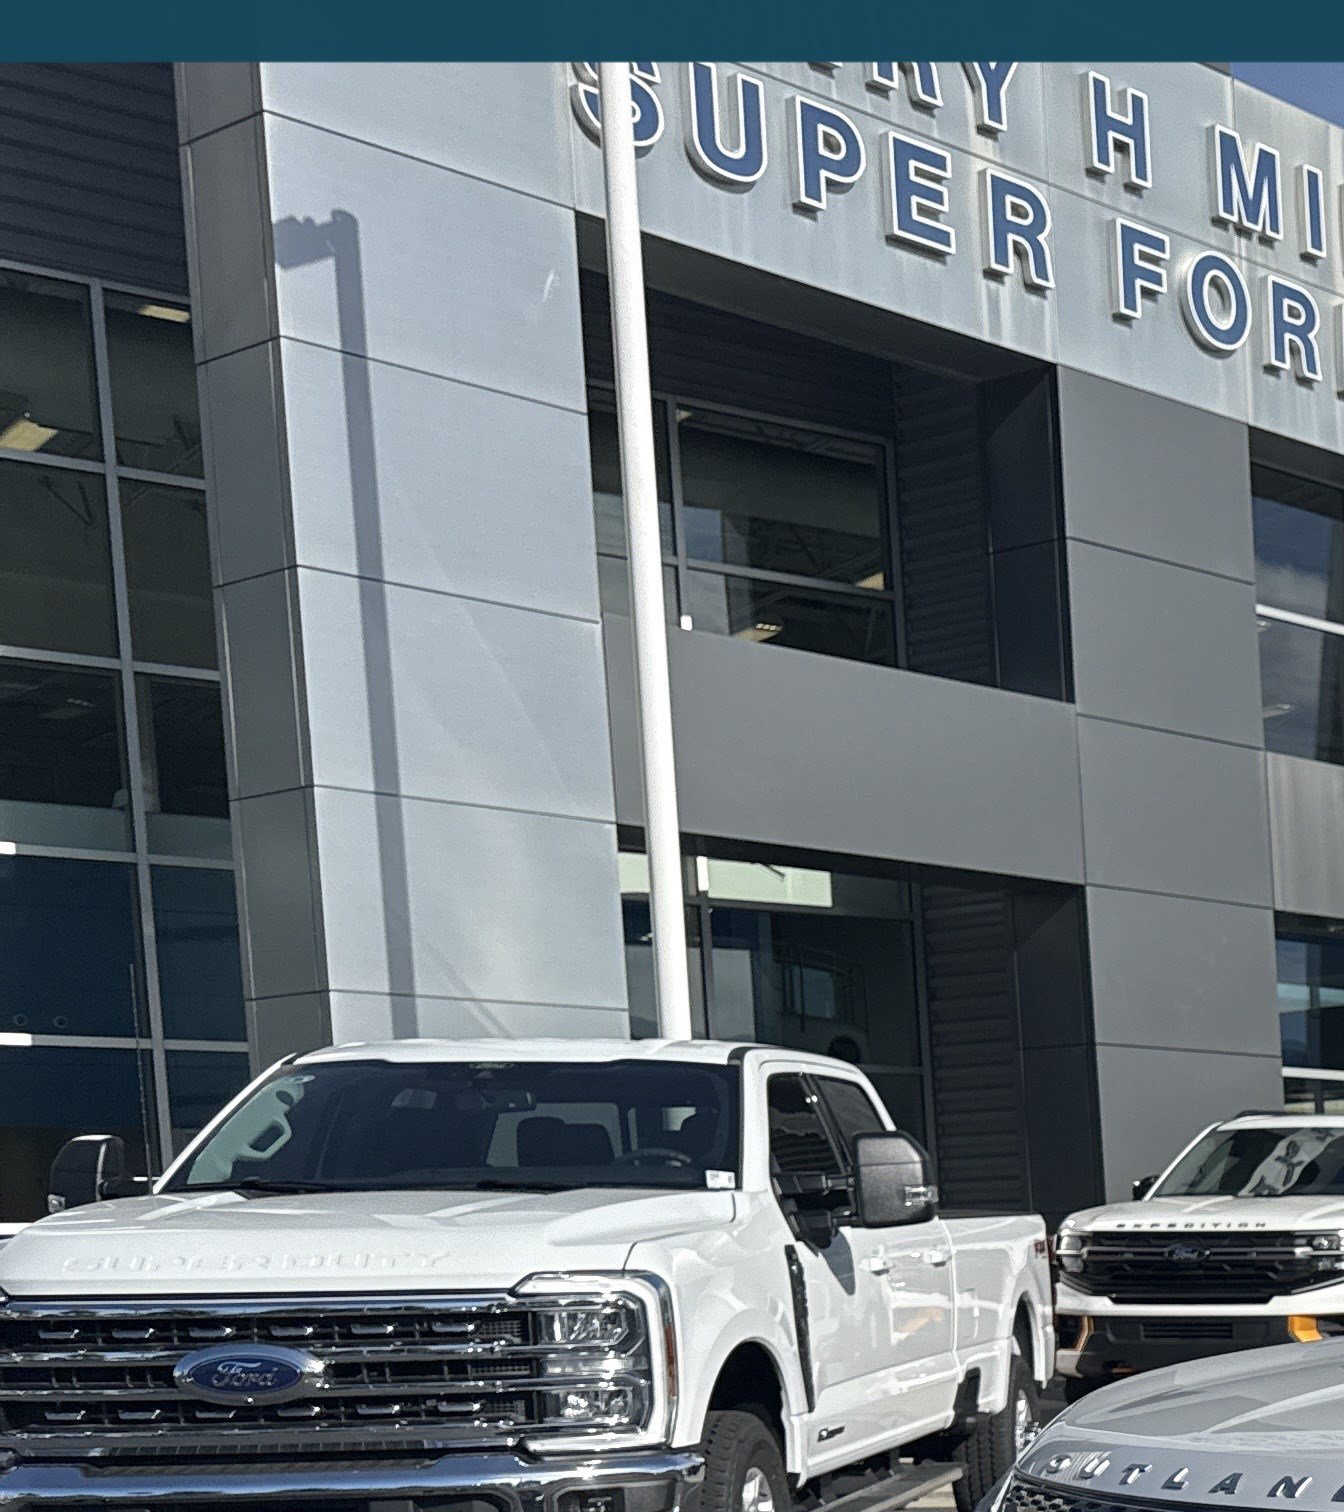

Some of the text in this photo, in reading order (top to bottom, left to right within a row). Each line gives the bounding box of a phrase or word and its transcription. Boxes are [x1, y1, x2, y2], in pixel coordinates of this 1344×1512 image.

[570, 62, 1056, 291] SUPER
[1082, 70, 1152, 190] H
[210, 1360, 280, 1389] Ford
